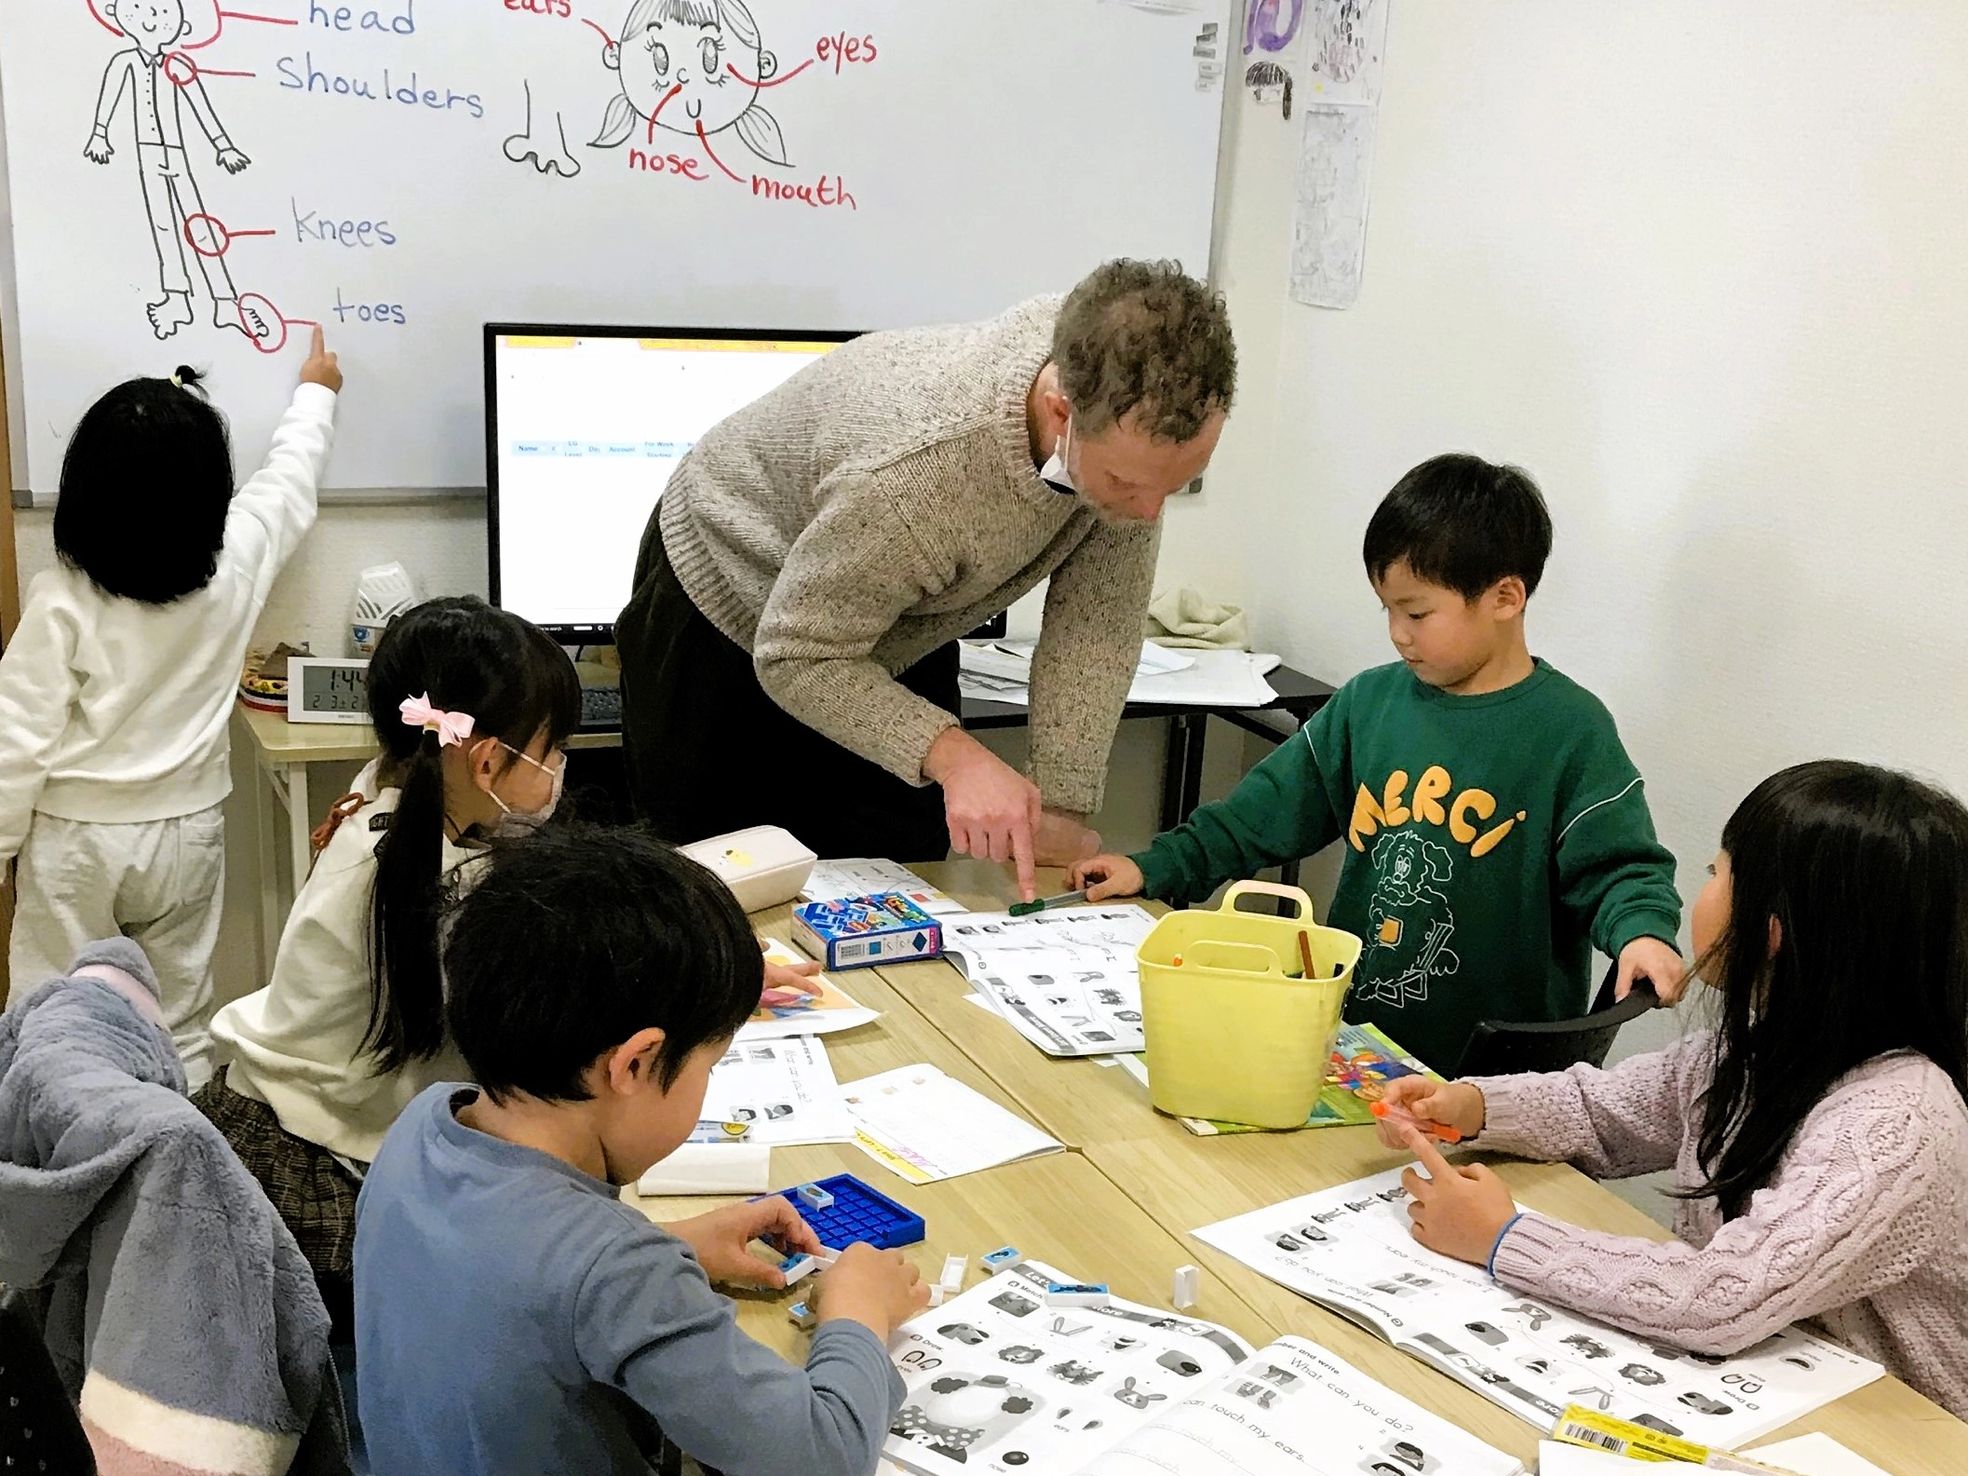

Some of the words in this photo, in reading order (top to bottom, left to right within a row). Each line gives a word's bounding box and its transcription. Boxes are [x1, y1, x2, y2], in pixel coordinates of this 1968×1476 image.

[309, 0, 415, 34] head
[815, 31, 877, 74] eyes
[628, 147, 709, 181] nose
[752, 174, 857, 210] mouth
[333, 286, 406, 324] toes
[1290, 1357, 1323, 1381] What
[1327, 1383, 1350, 1399] can
[1353, 1400, 1379, 1417] you
[1385, 1415, 1414, 1433] do?
[1535, 1399, 1559, 1417] ore
[1210, 1402, 1245, 1425] touch
[1248, 1422, 1271, 1439] my
